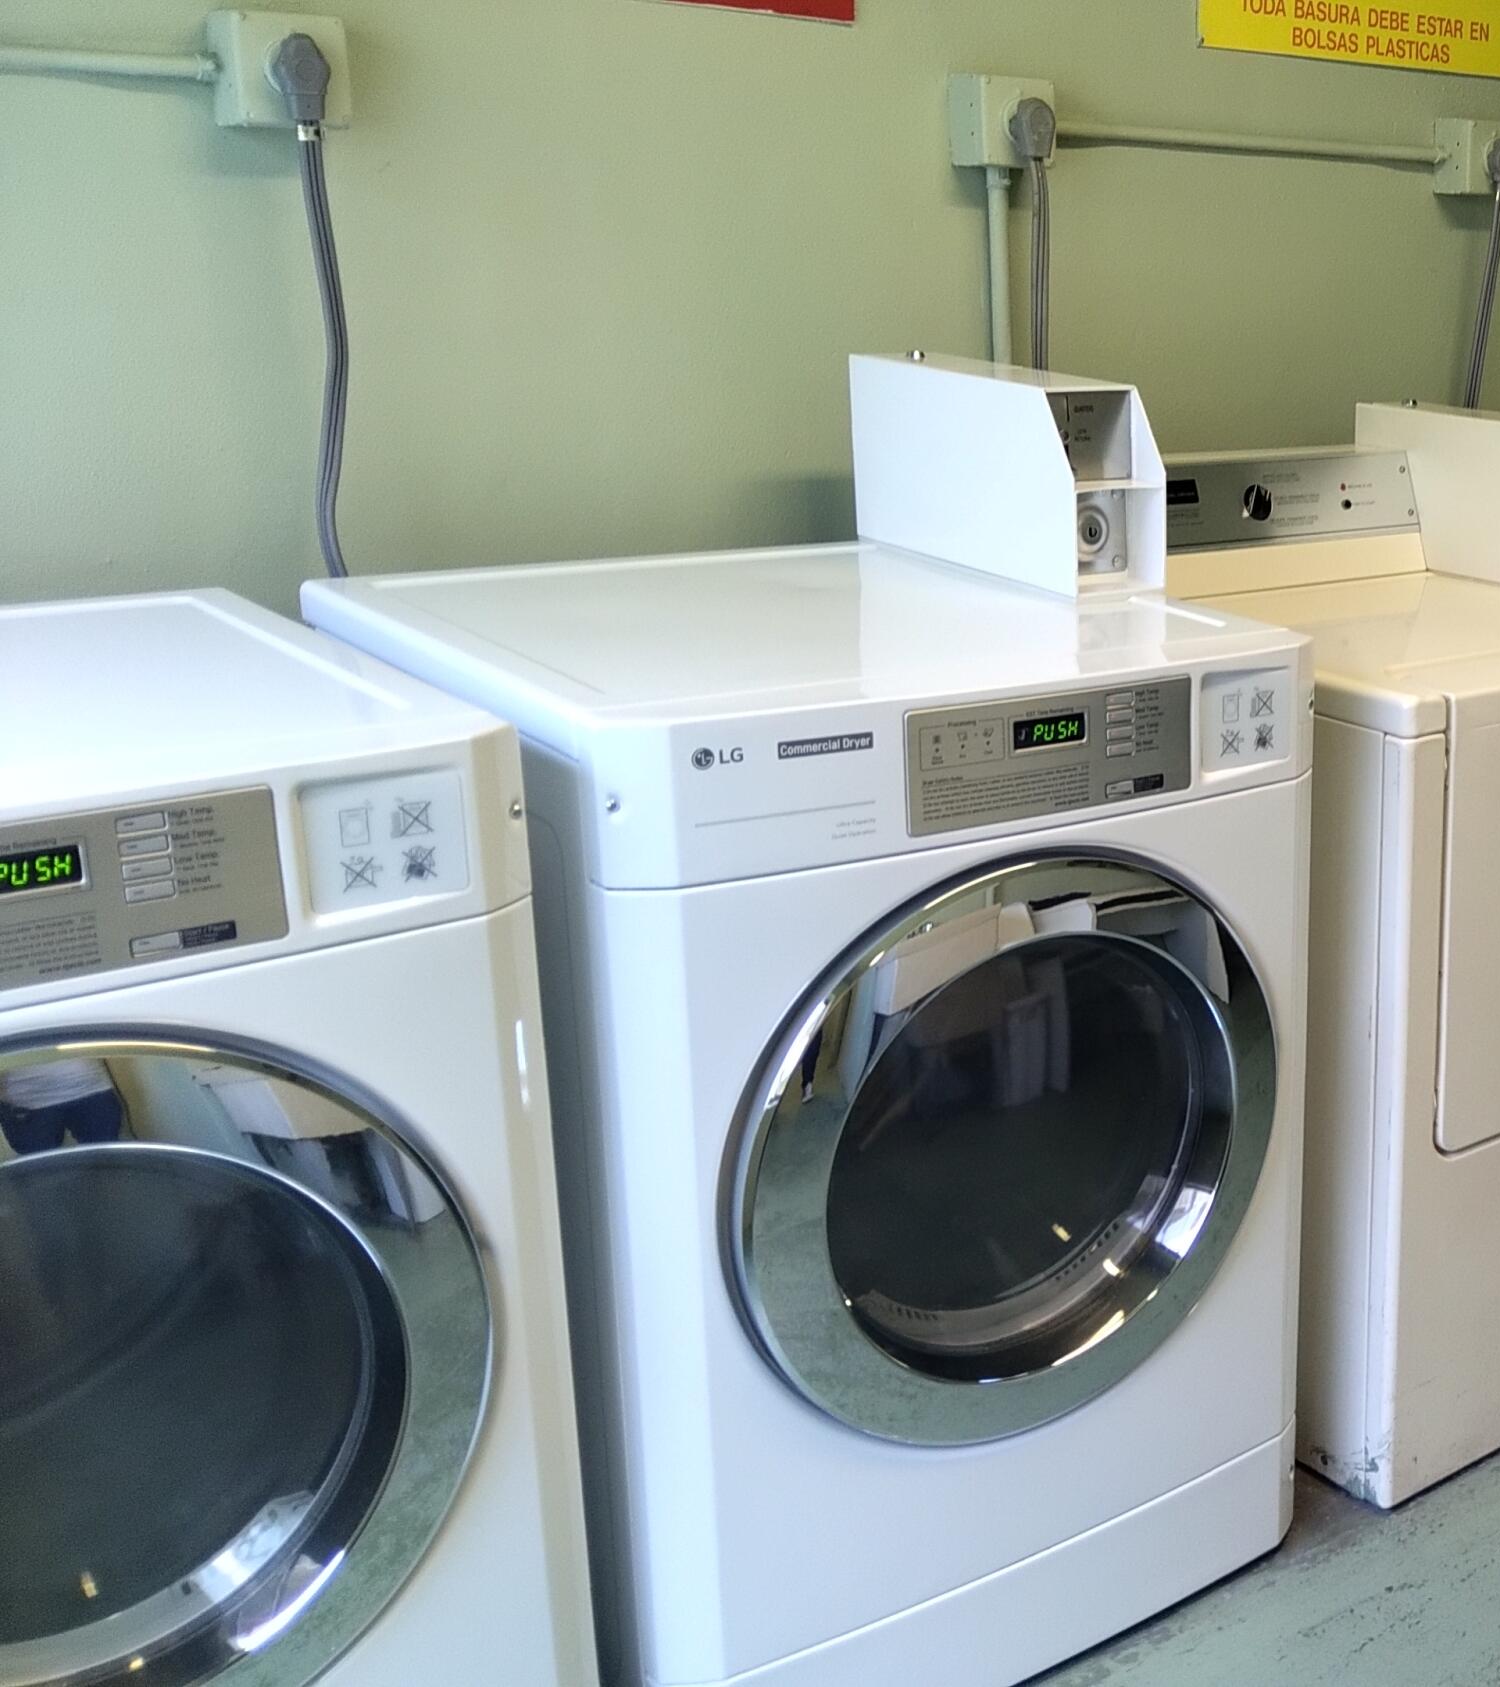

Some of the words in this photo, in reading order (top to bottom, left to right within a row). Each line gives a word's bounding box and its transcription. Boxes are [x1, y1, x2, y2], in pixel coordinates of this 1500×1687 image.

[1294, 0, 1361, 26] BASURA
[1368, 8, 1410, 33] DEBE
[1416, 14, 1464, 39] ESTAR
[1470, 22, 1490, 42] EN
[1292, 26, 1359, 54] BOLSAS
[1366, 35, 1451, 65] PLASTICAS
[1032, 720, 1080, 742] PUSH
[718, 747, 744, 764] LG
[779, 737, 841, 757] Commercial
[842, 734, 872, 751] Dryer
